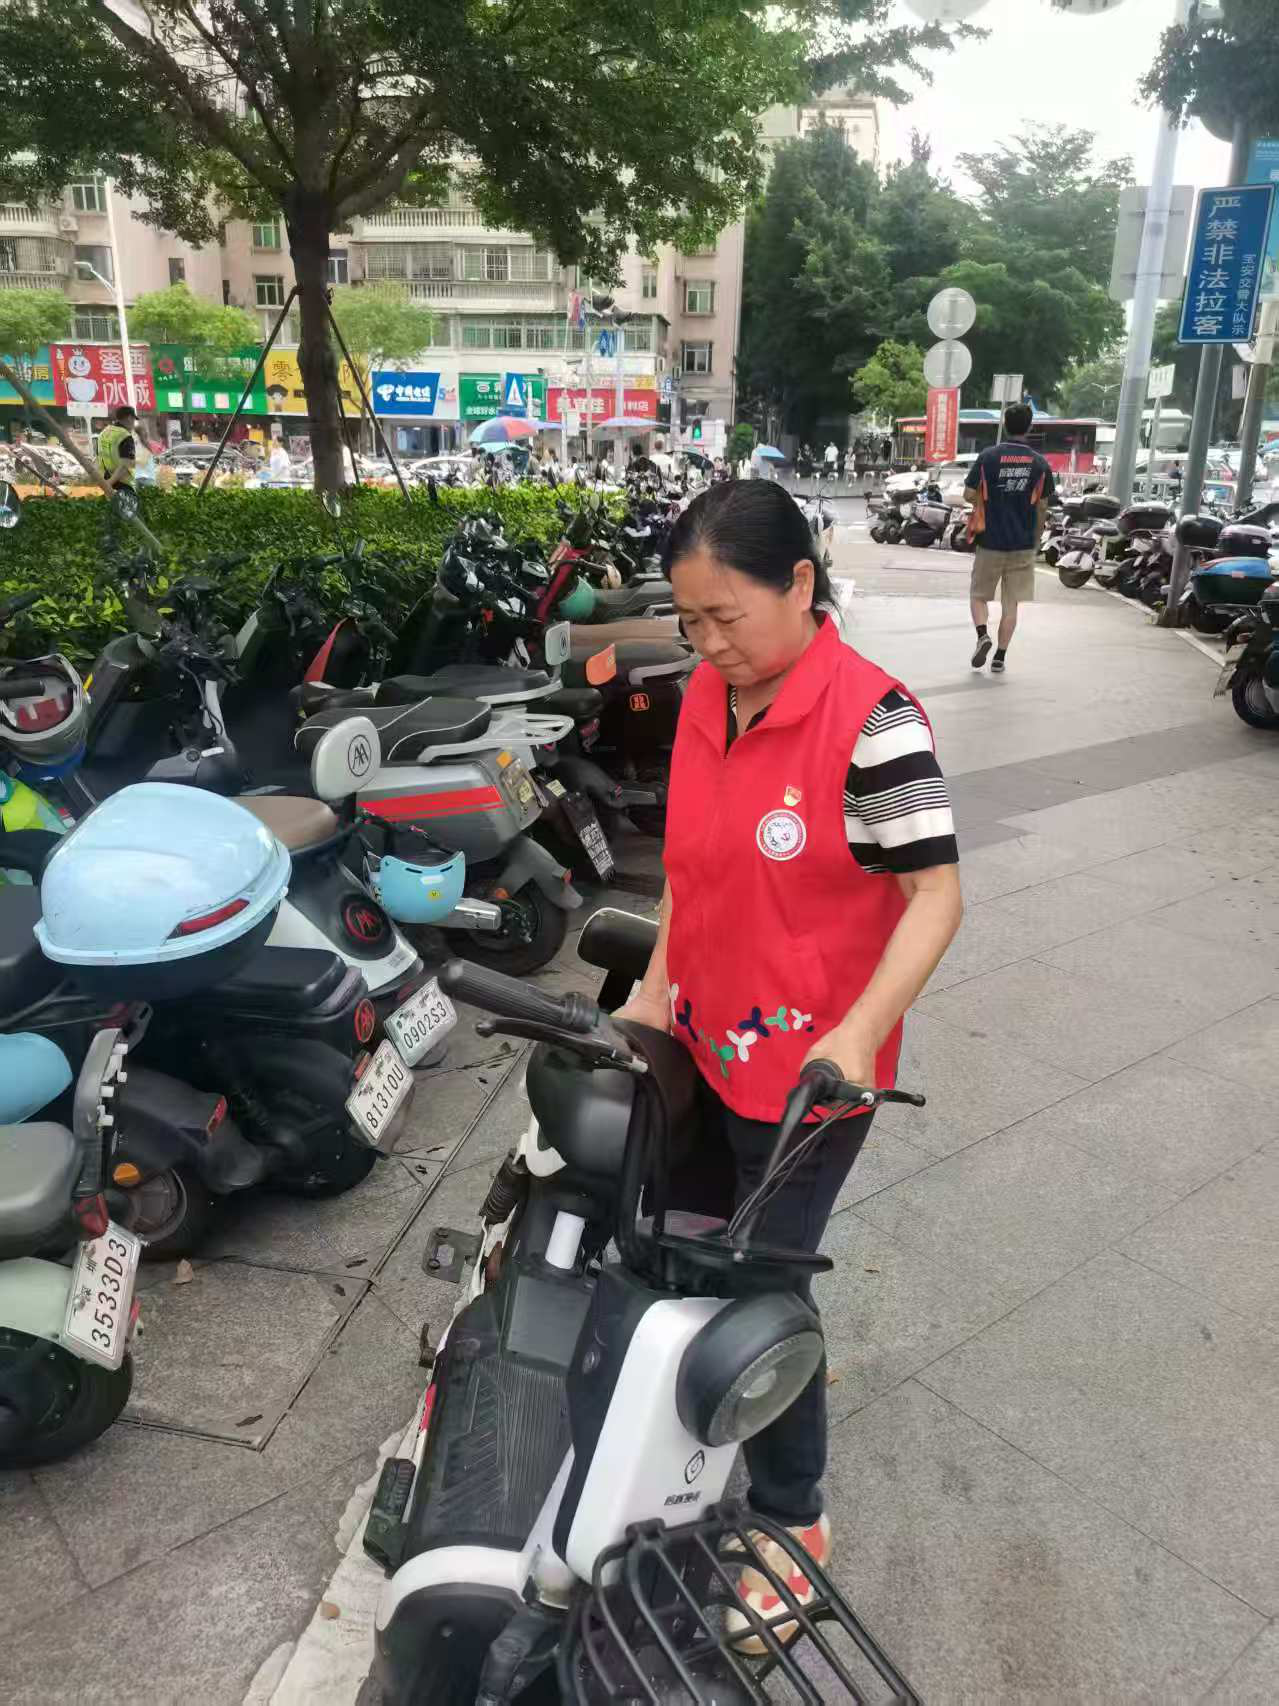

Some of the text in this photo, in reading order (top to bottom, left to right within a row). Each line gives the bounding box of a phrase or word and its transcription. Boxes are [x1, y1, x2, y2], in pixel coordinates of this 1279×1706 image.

[1192, 196, 1241, 336] 严禁非法拉客
[91, 1238, 127, 1348] 3533D3
